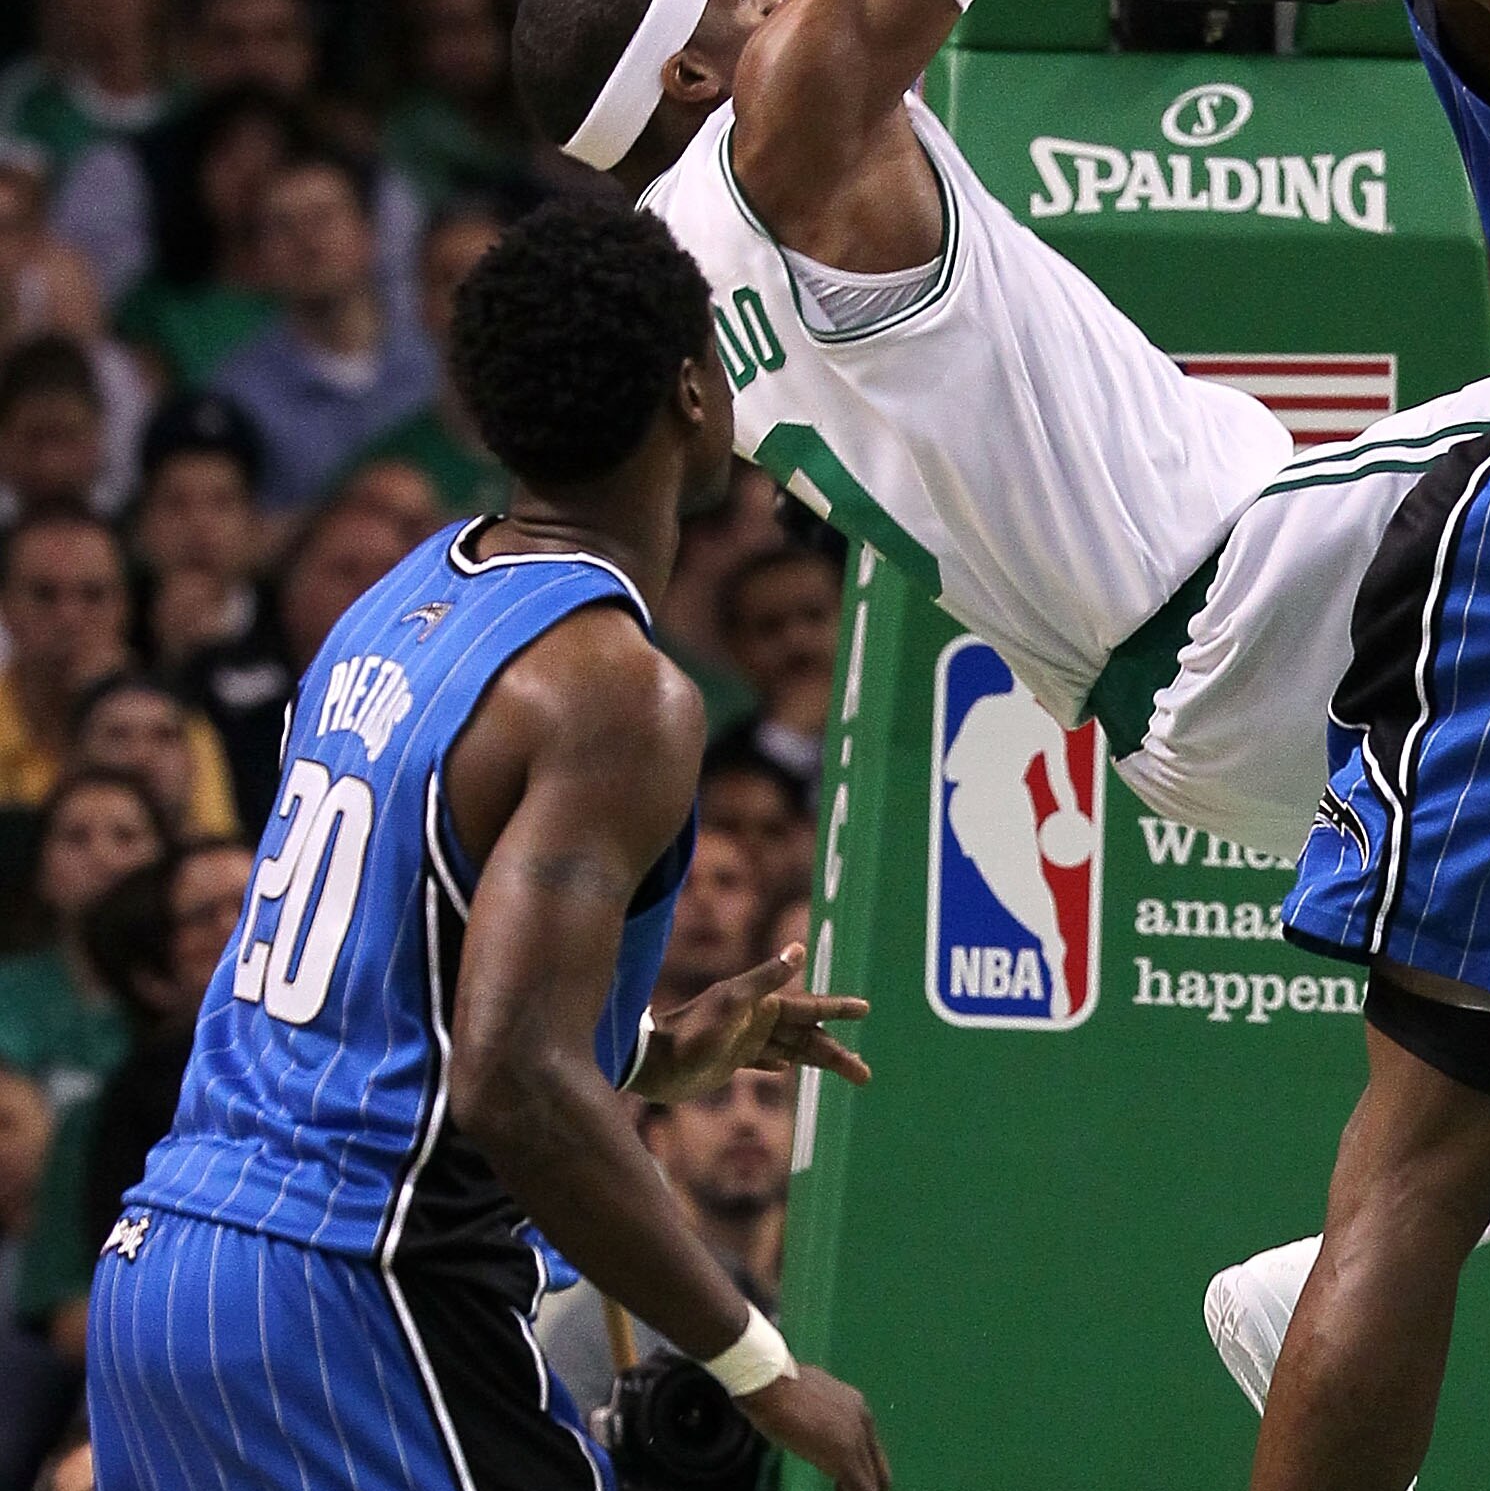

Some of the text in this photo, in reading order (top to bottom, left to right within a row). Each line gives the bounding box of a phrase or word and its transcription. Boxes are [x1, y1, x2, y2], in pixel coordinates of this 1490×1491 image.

[1029, 136, 1388, 234] SPALDING
[234, 758, 374, 1024] 20
[950, 946, 1044, 1001] NBA
[1132, 956, 1369, 1024] happen
